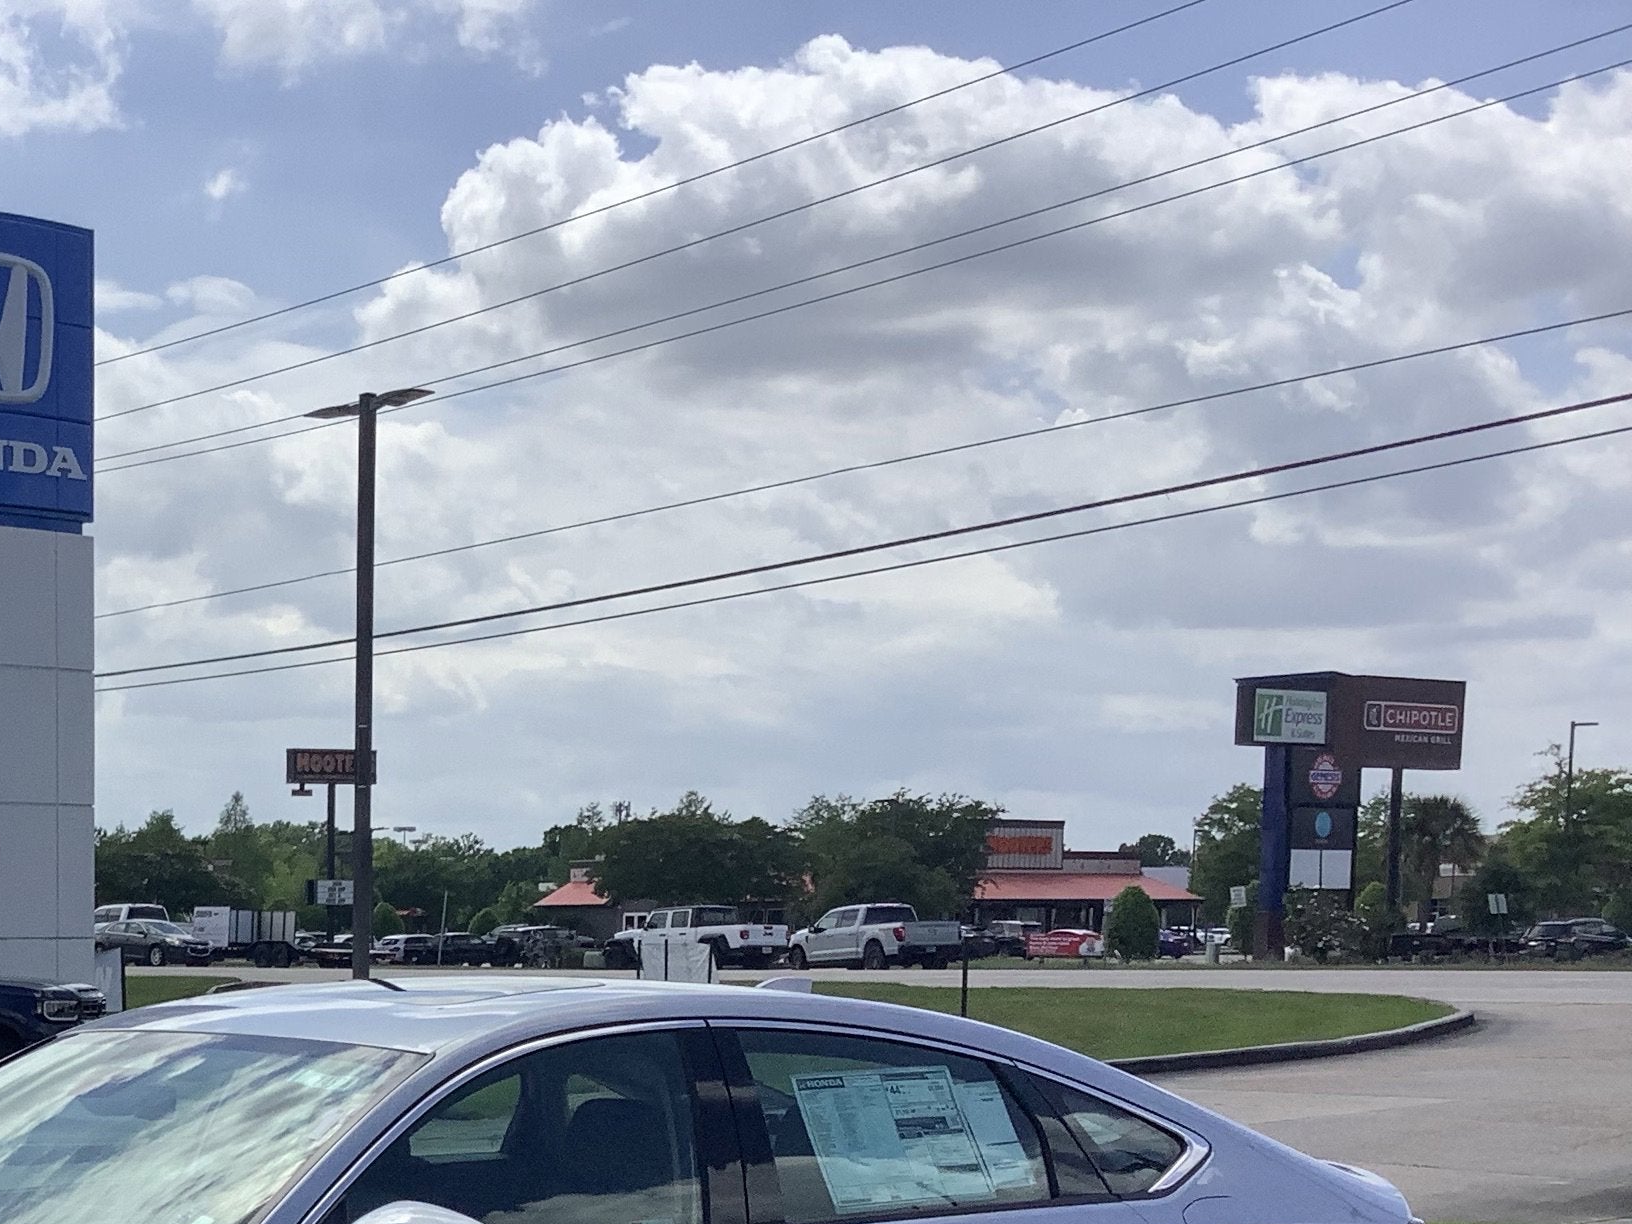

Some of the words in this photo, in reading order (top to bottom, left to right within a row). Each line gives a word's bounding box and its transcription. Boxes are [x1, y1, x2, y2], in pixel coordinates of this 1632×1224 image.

[1284, 708, 1324, 727] Express
[1386, 709, 1454, 727] CHIPOTLE
[1394, 734, 1428, 743] MEXICAN
[1430, 736, 1452, 745] GRILL
[296, 752, 354, 773] HOOTE
[806, 1078, 842, 1089] HONDA
